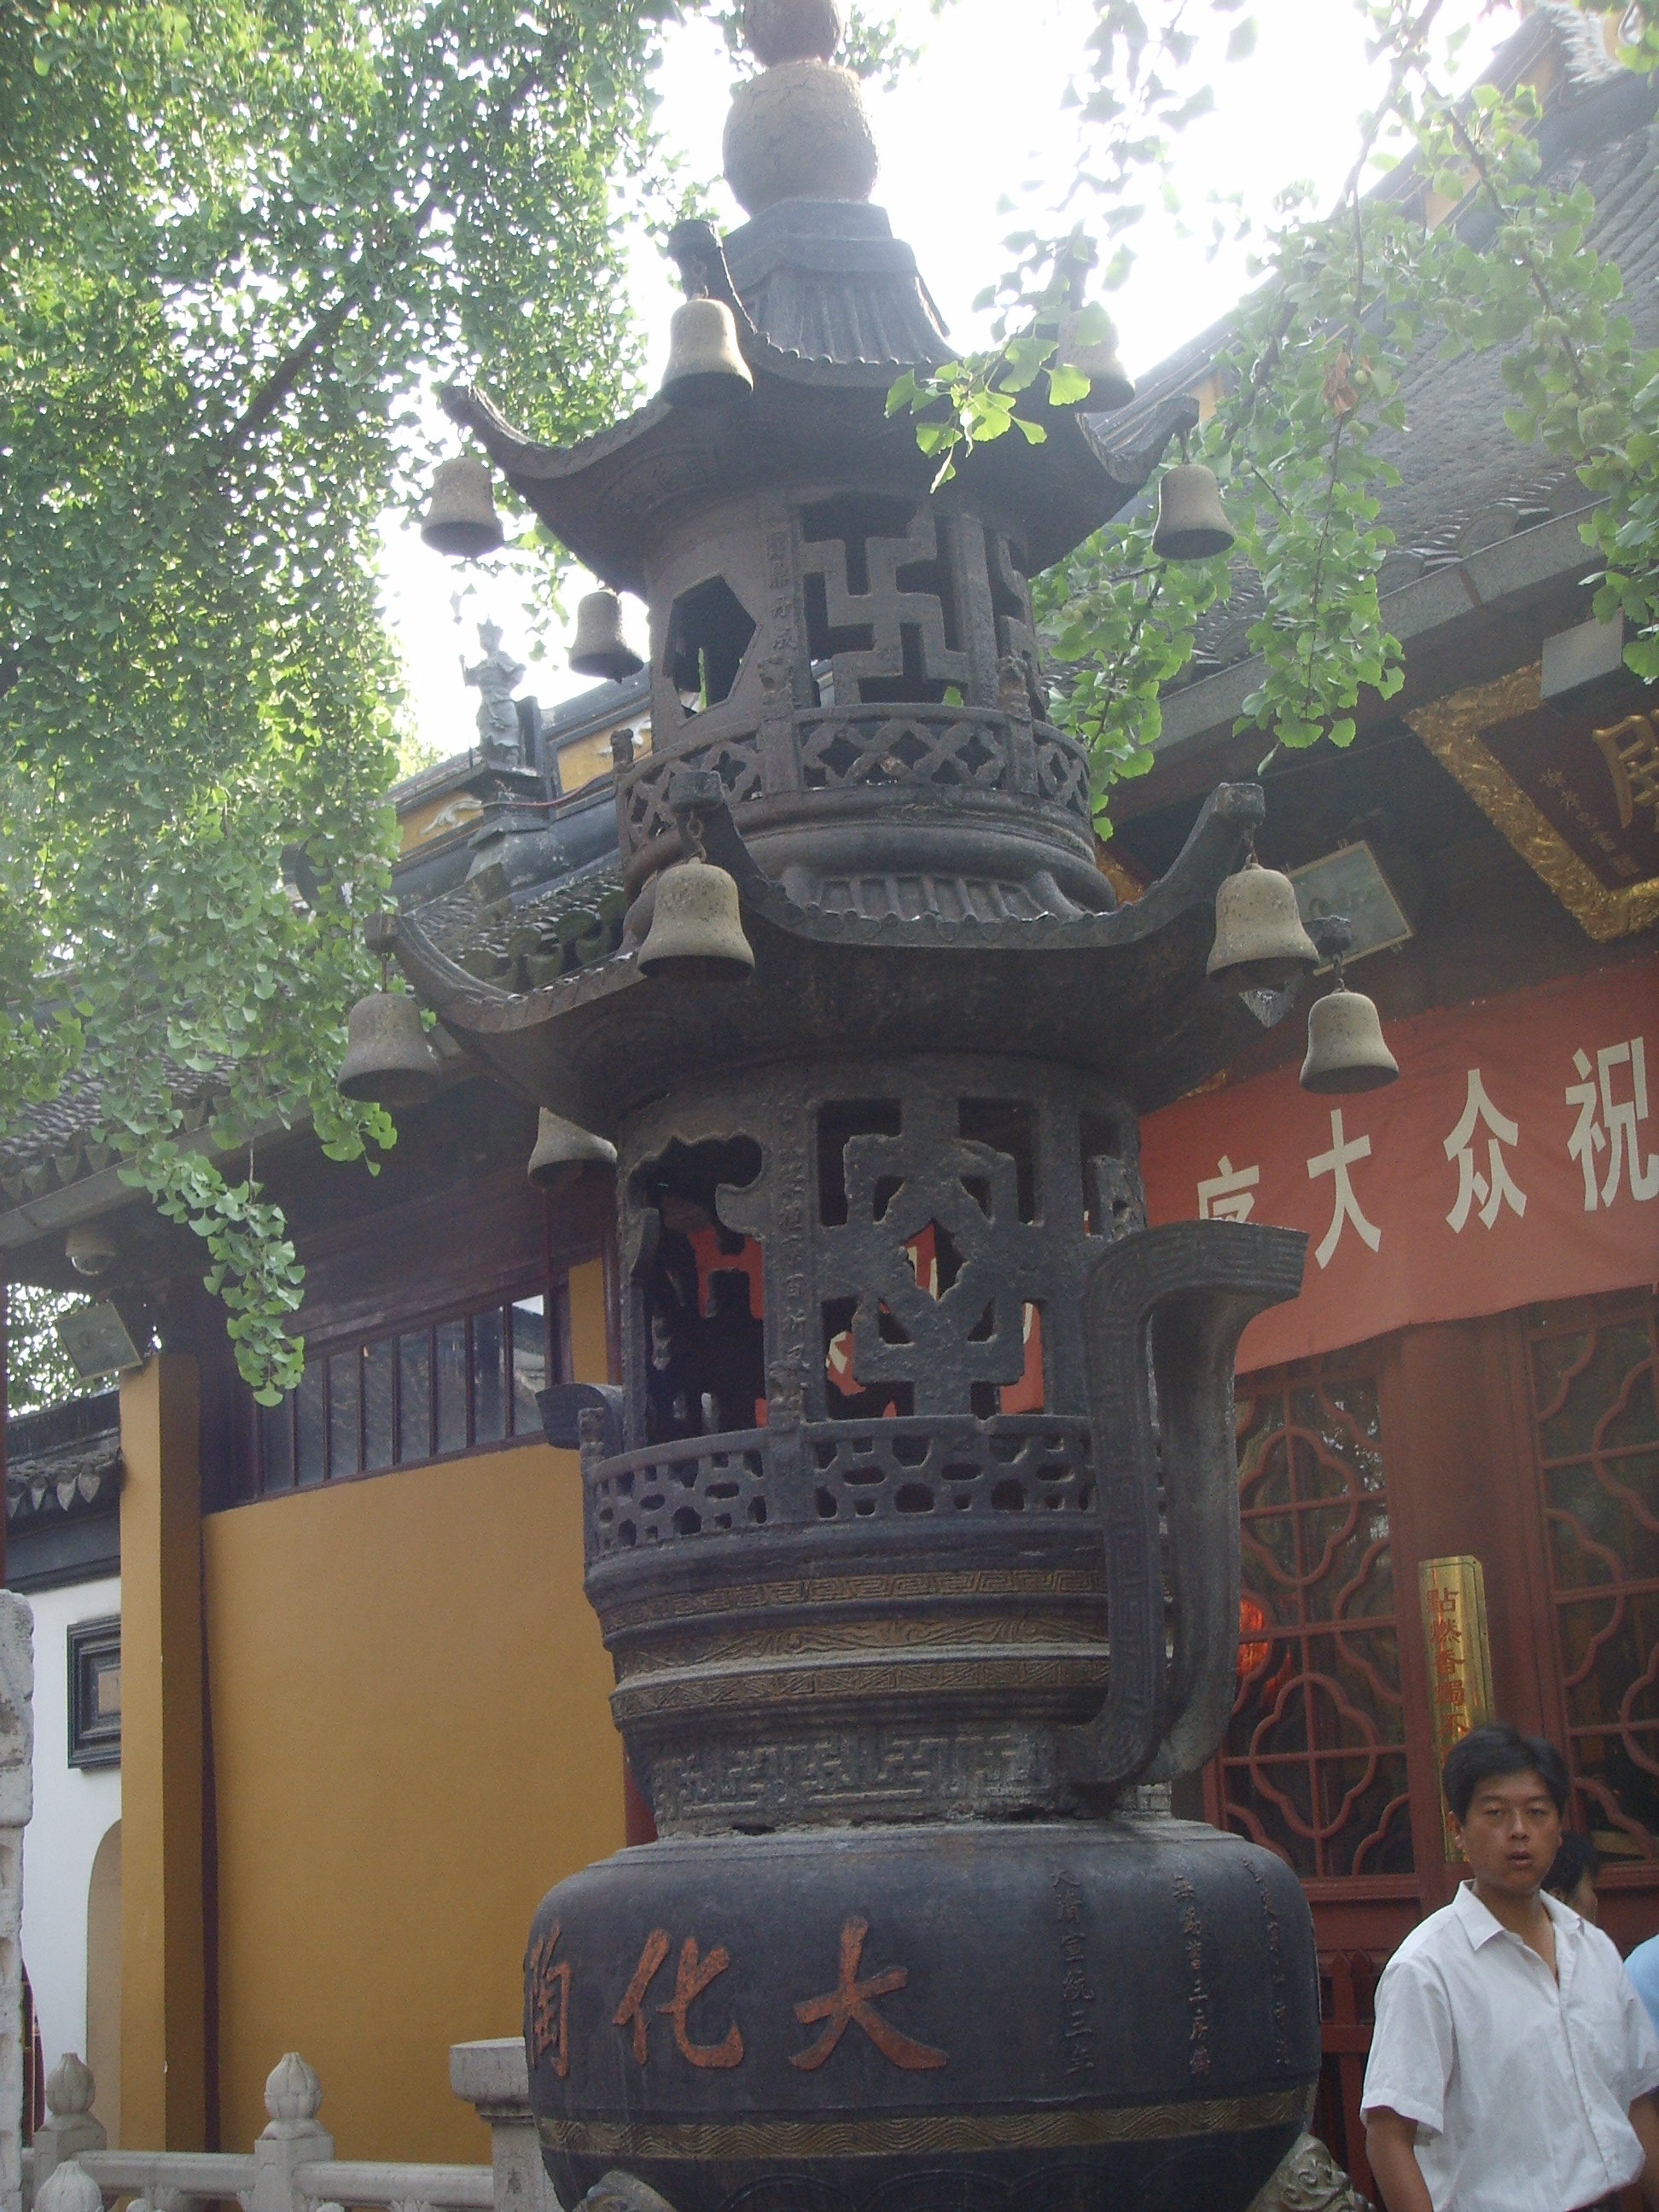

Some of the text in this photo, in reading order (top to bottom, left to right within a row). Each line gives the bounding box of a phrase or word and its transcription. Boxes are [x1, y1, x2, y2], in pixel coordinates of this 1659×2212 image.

[1426, 1586, 1471, 1768] 點燃香燭不
